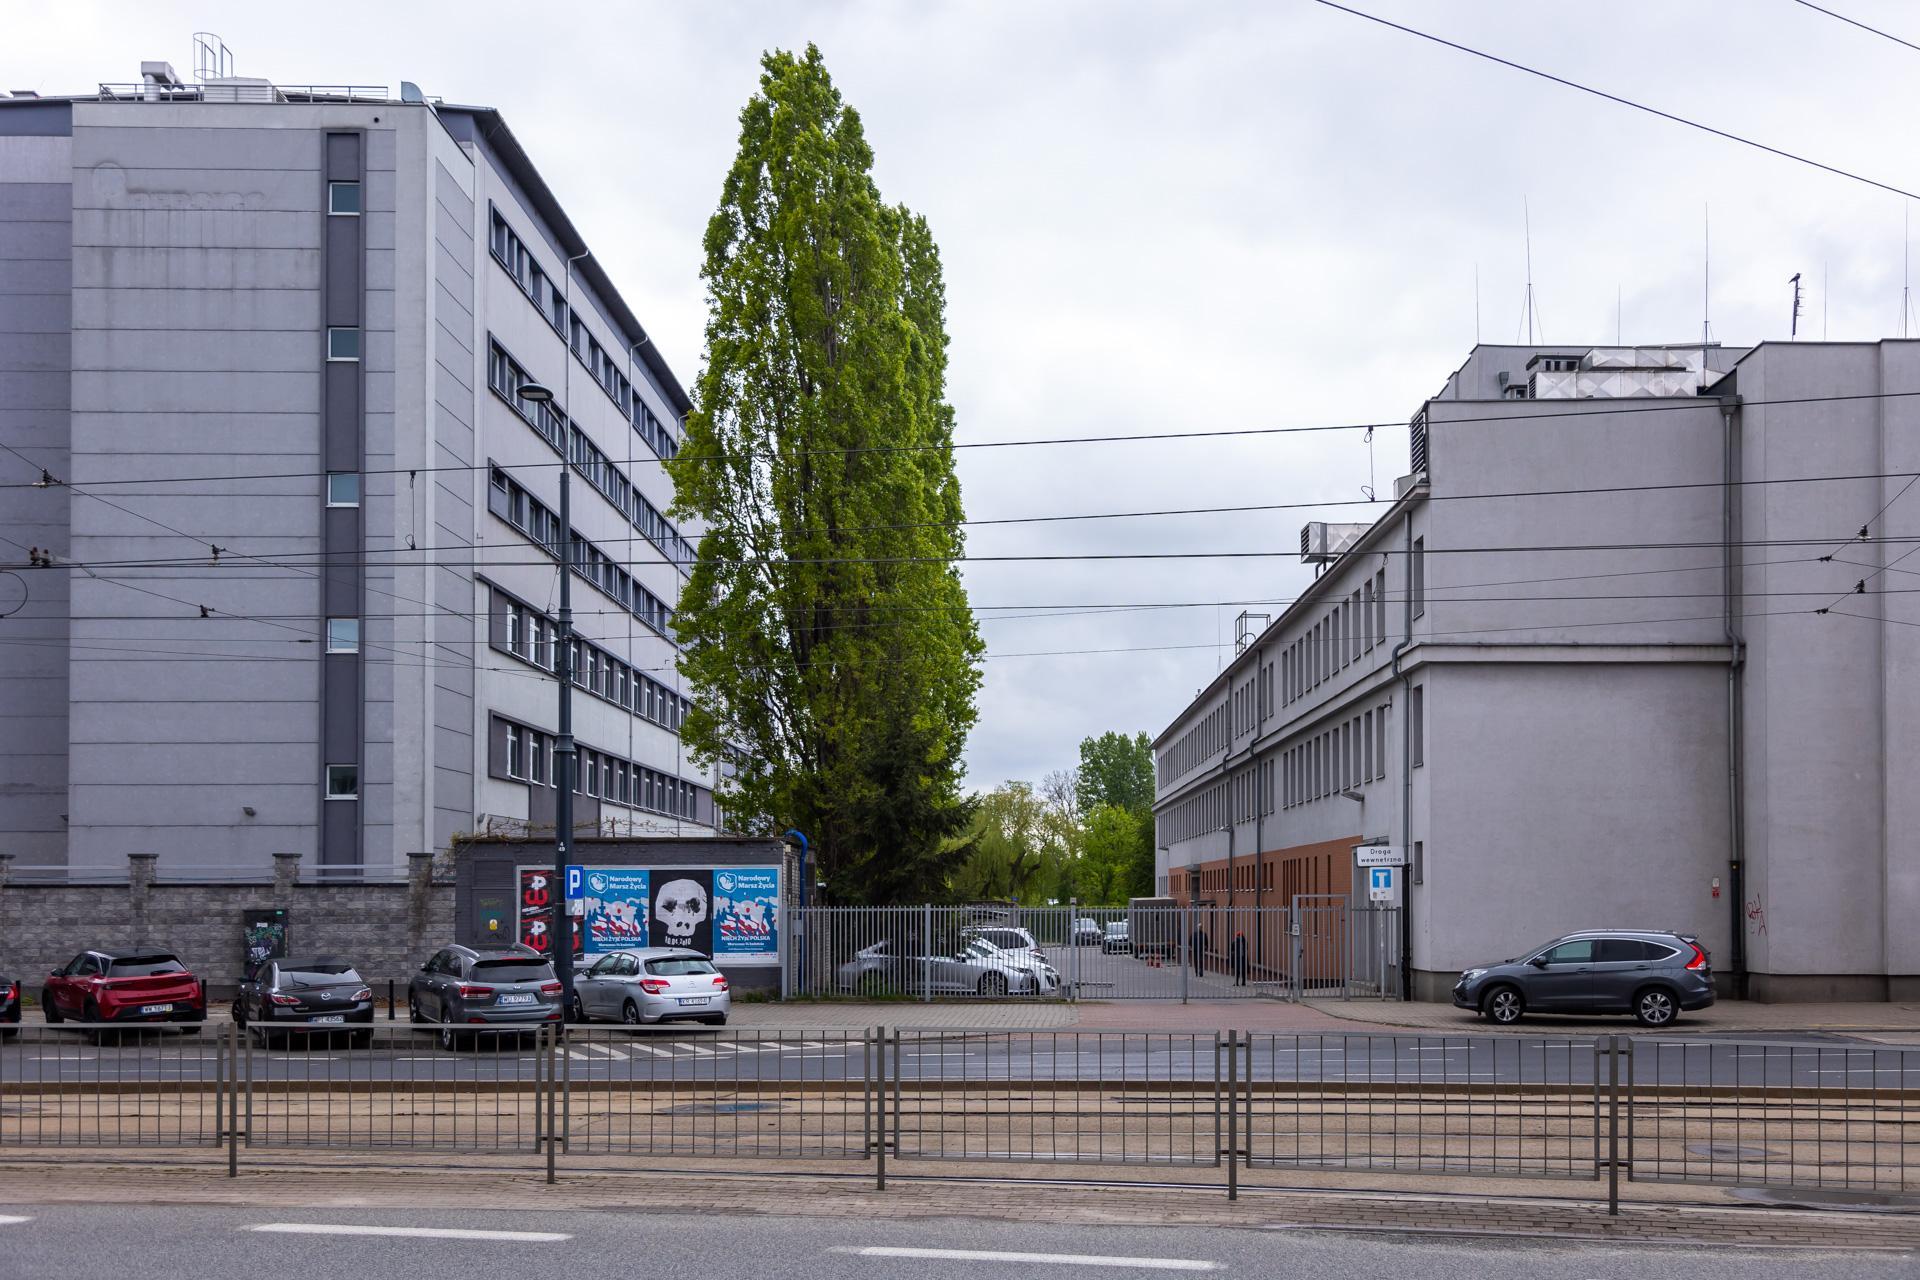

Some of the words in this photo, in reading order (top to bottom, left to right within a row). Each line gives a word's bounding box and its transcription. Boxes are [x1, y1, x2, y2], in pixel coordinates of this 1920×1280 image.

[1370, 848, 1392, 856] Droga
[569, 869, 580, 895] P
[609, 876, 642, 884] Narodowy
[737, 874, 771, 883] Narodowy
[609, 882, 630, 890] Marsz
[630, 881, 647, 891] Życia
[737, 882, 758, 890] Marsz
[758, 880, 775, 890] Życia
